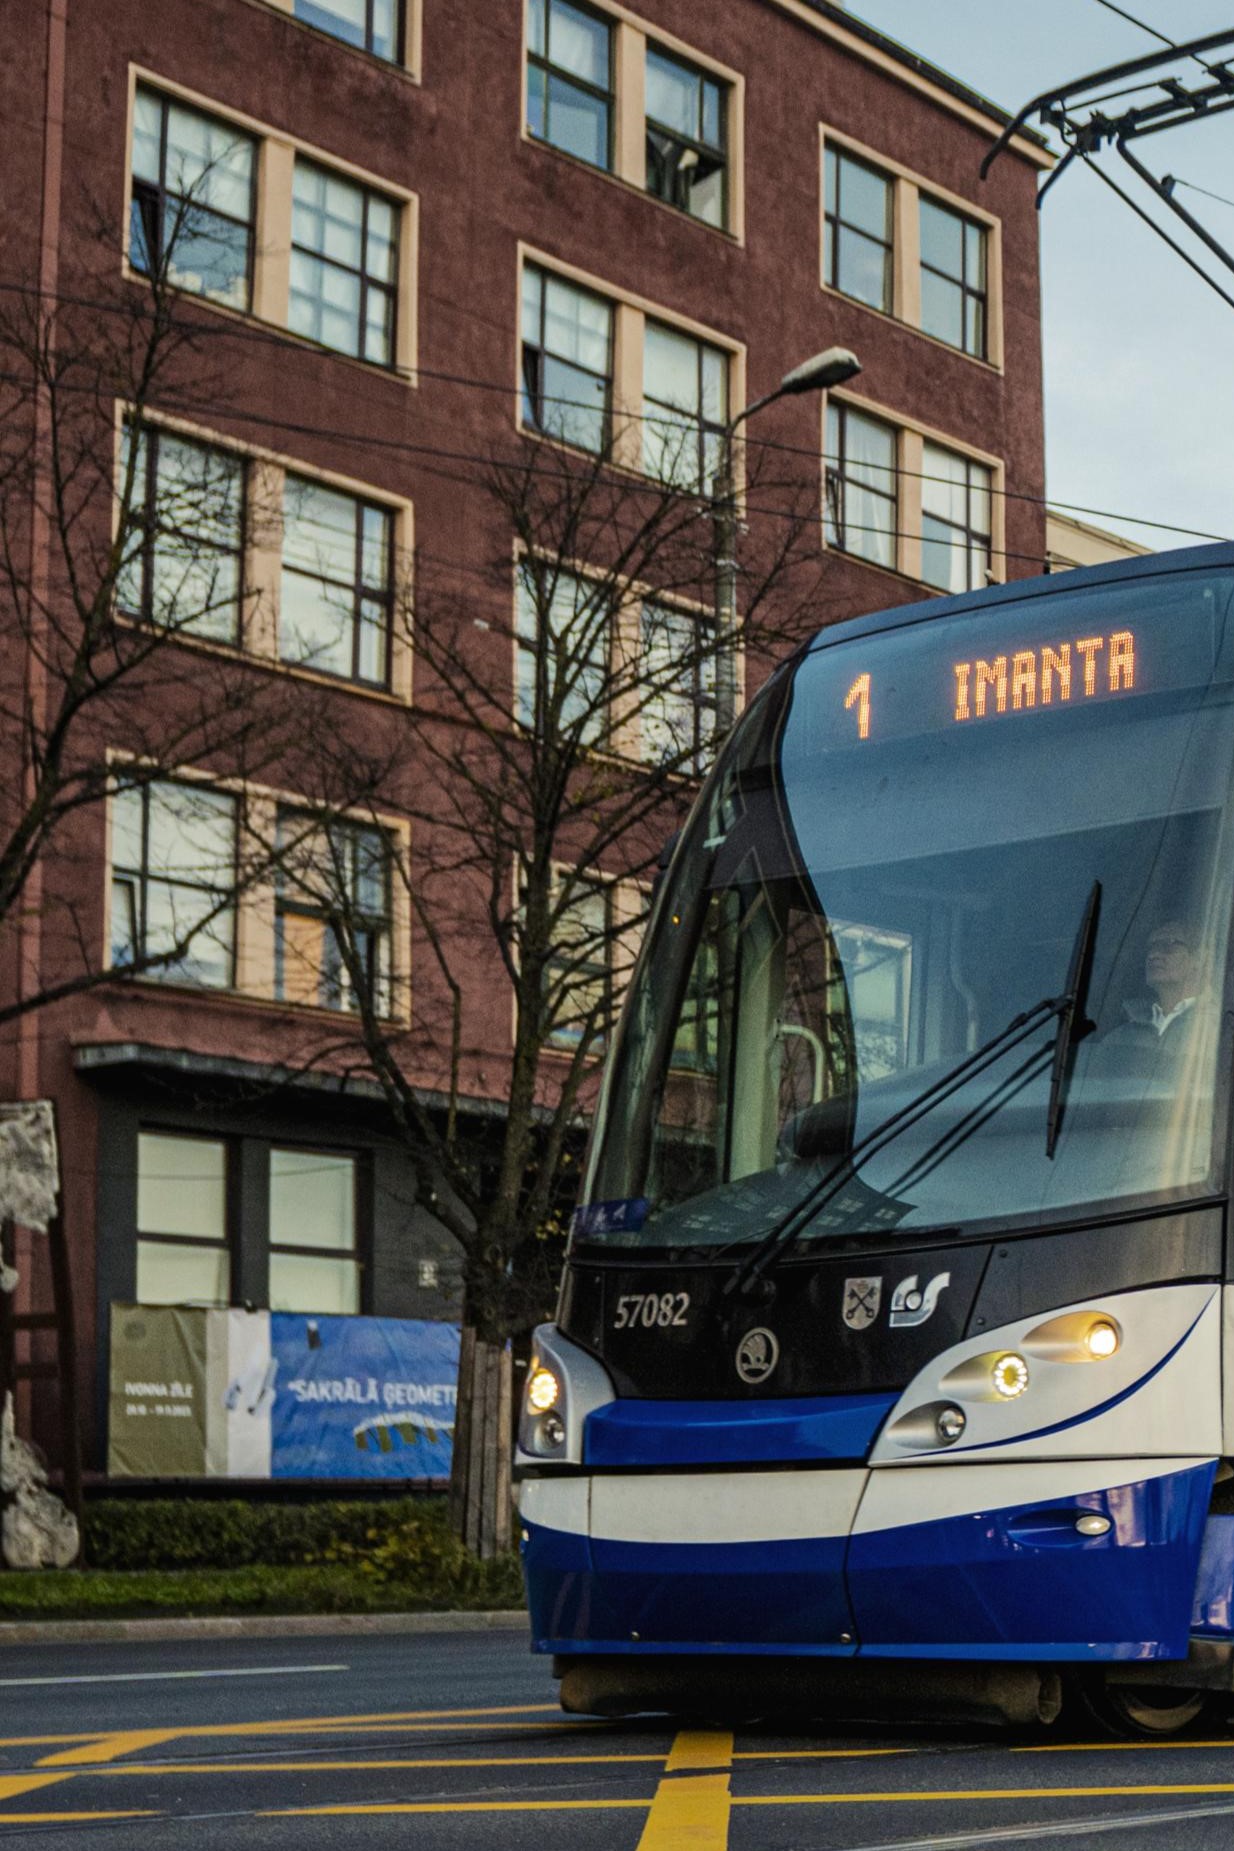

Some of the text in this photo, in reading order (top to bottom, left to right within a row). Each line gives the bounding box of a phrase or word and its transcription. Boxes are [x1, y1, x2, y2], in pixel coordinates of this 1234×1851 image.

[844, 631, 1135, 739] 1 IMANTA
[613, 1291, 690, 1329] 57082
